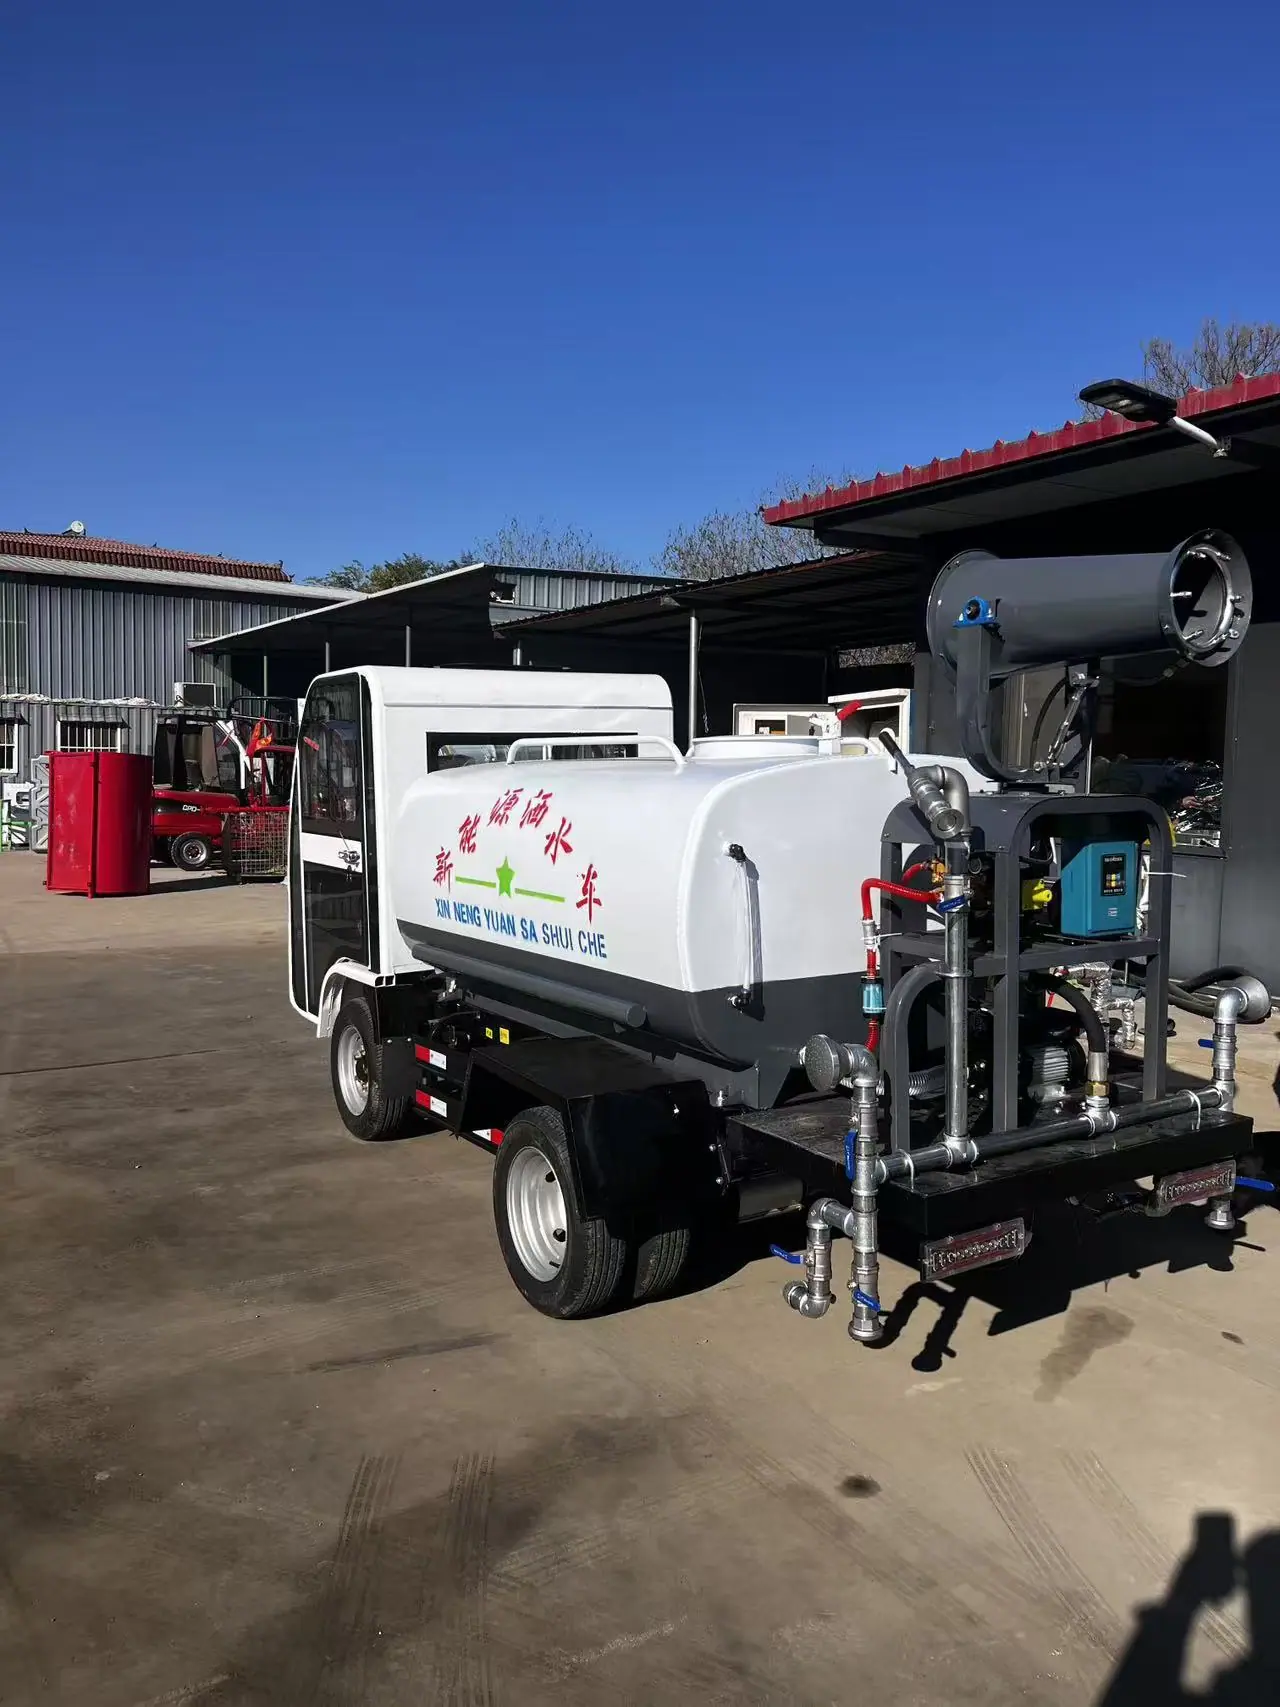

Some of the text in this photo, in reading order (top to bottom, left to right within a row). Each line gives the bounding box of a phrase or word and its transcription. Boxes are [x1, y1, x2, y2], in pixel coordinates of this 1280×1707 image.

[435, 898, 607, 959] XIN NENG YUAN SA SHUI CHE
